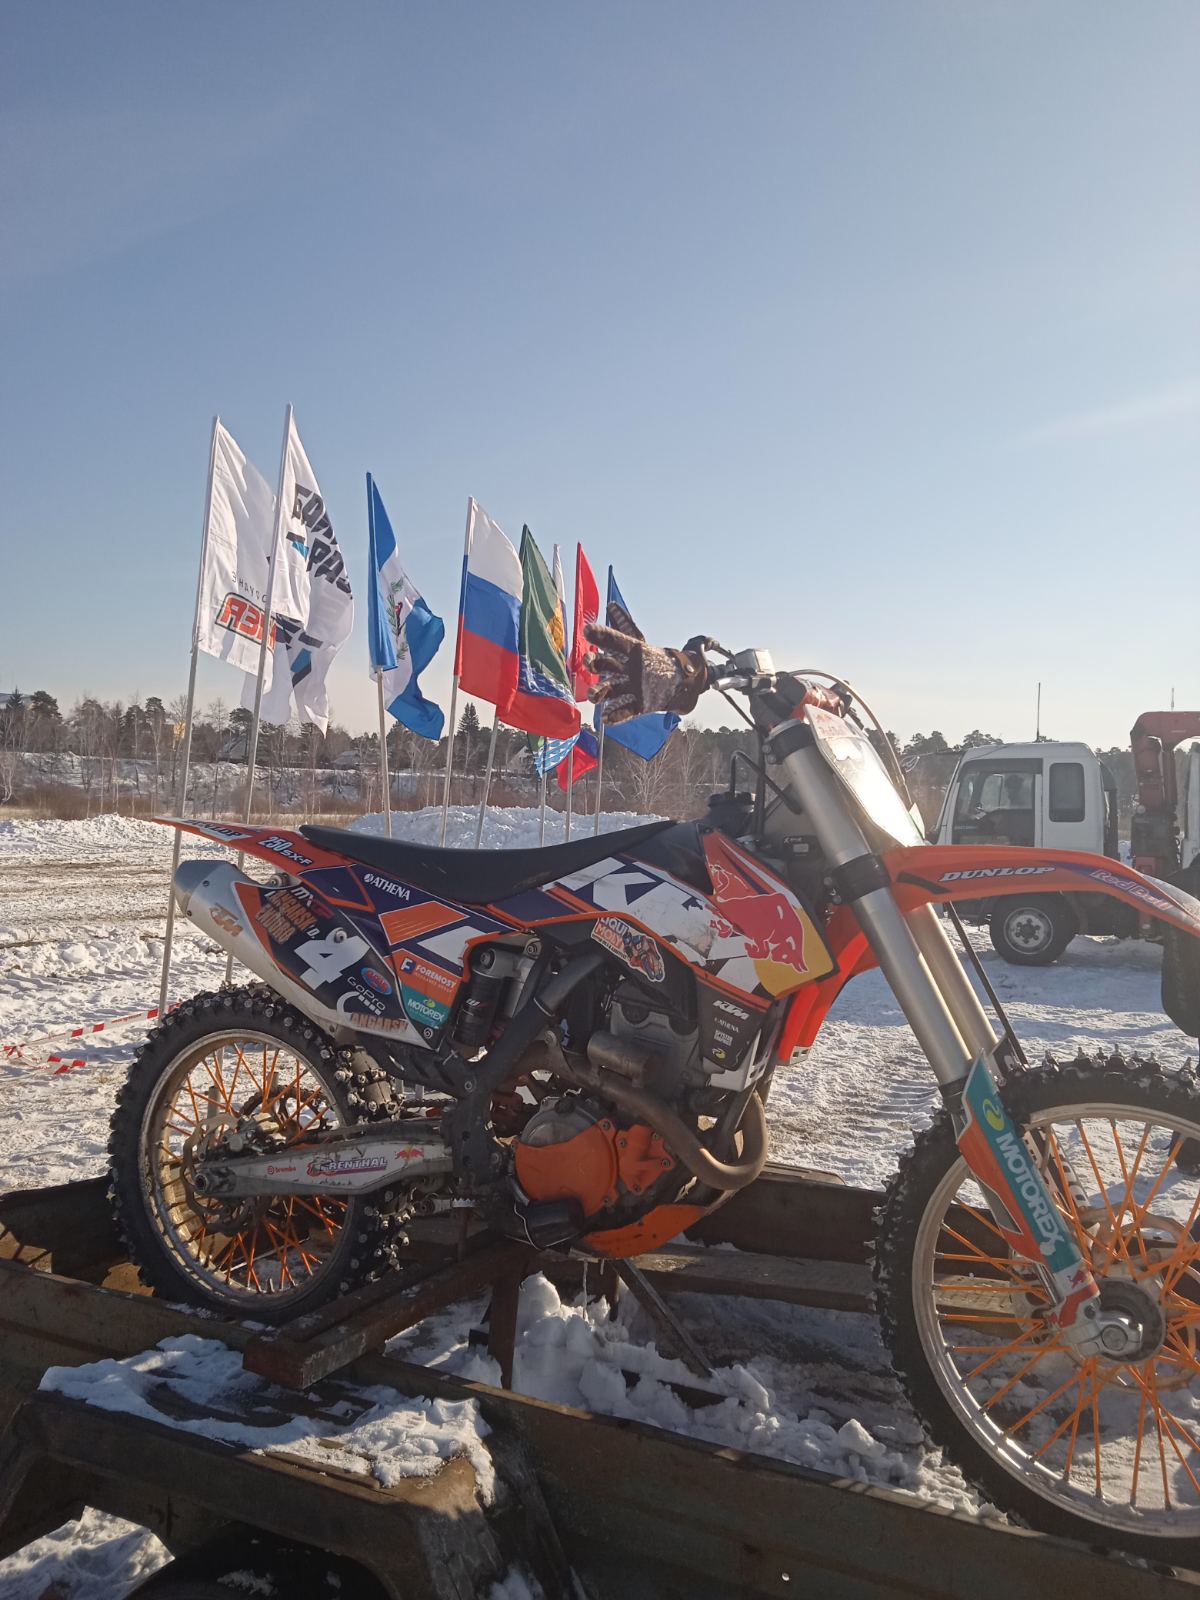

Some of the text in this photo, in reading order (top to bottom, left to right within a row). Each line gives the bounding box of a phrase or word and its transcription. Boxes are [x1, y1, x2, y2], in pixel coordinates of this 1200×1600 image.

[257, 836, 313, 866] 250 SX-F
[938, 866, 1056, 883] DUNLOP
[370, 876, 411, 901] ATHENA
[415, 964, 457, 989] FOREMOST
[347, 976, 386, 1011] GoPro
[407, 998, 445, 1022] MOTOREX
[712, 1000, 750, 1020] KTM
[329, 1156, 388, 1171] RENTHAL
[996, 1131, 1066, 1256] MOTOREX
